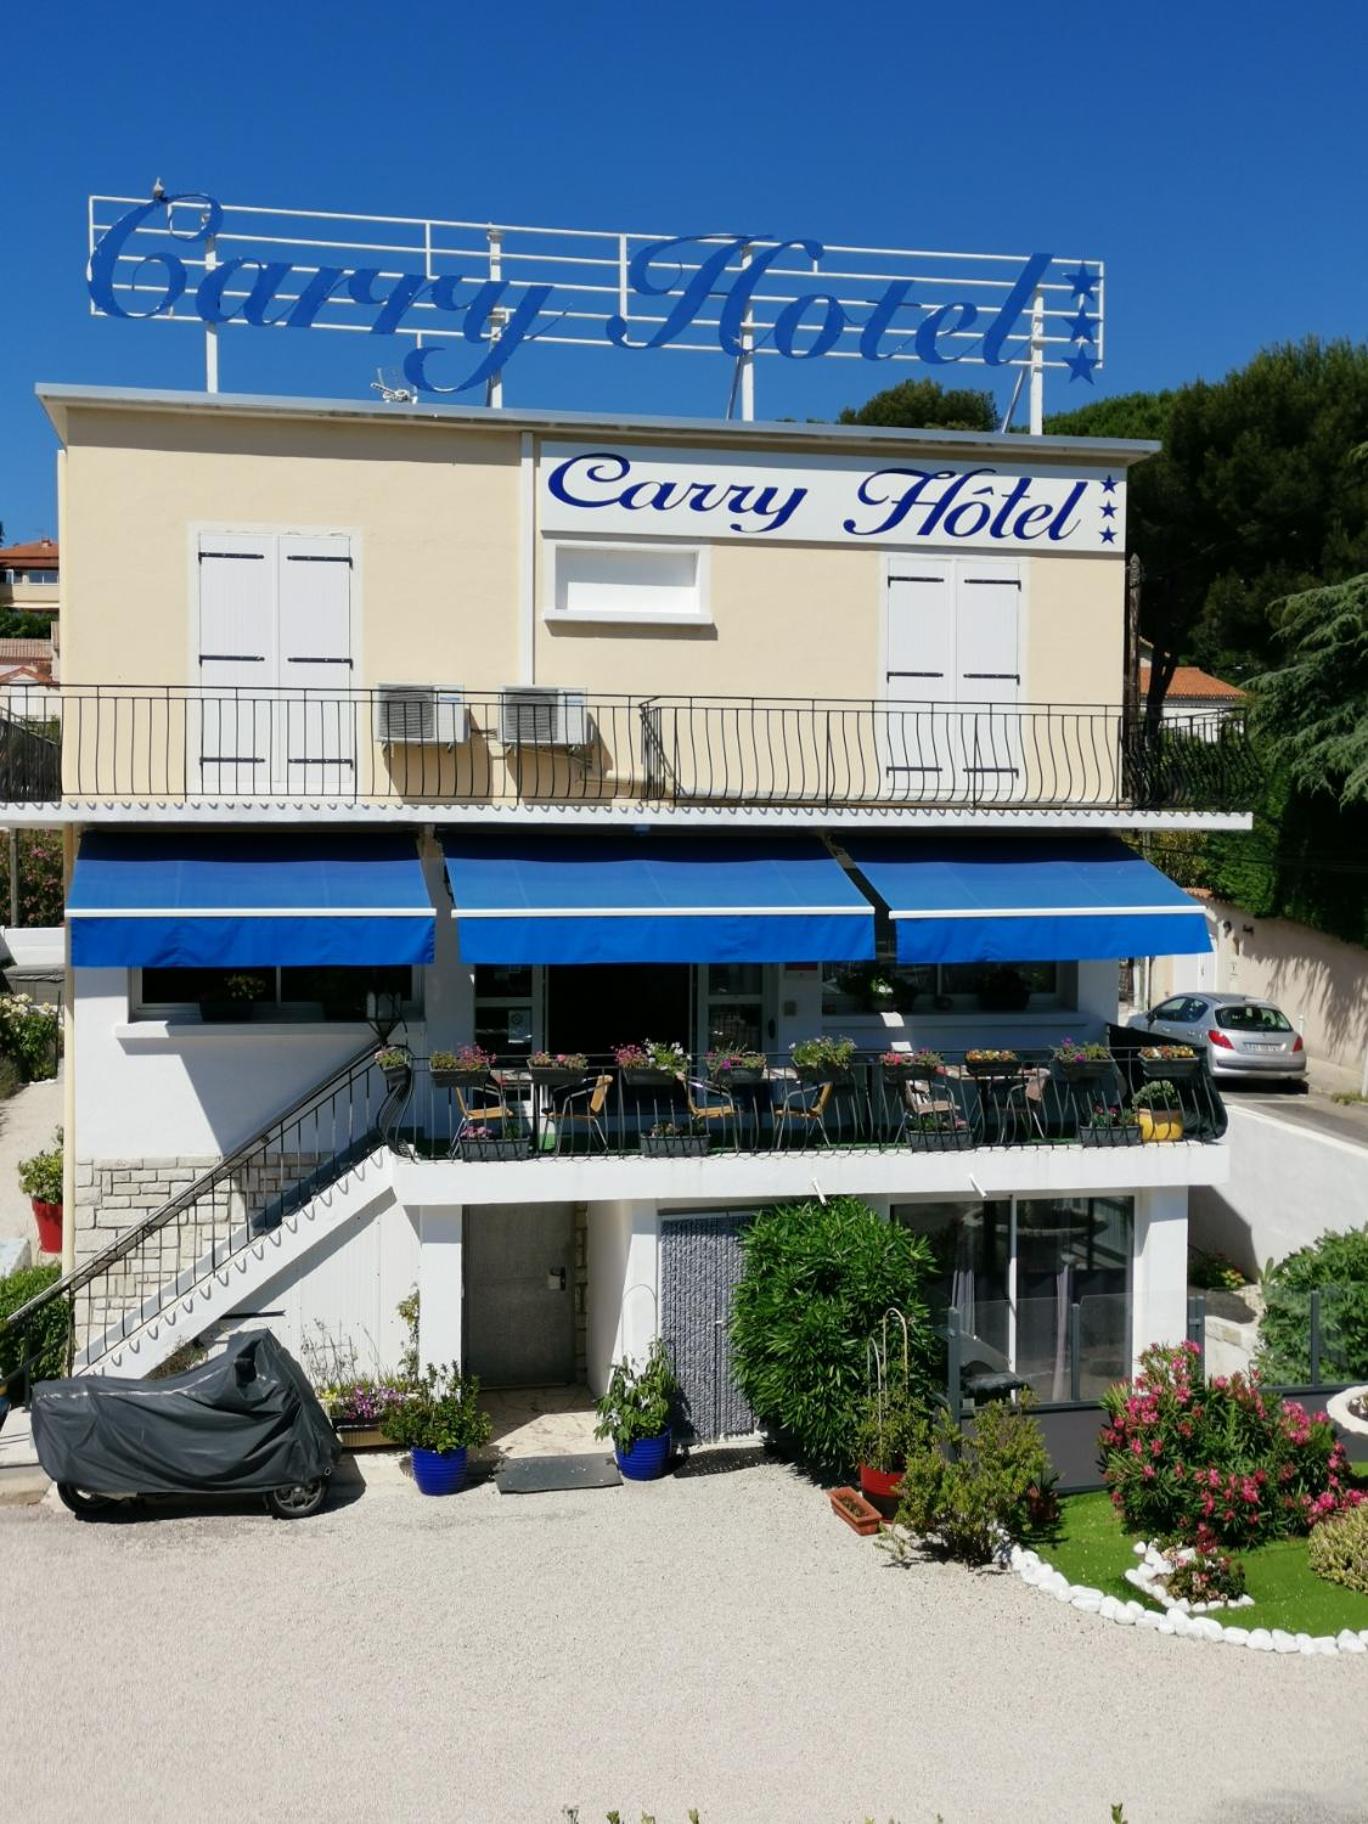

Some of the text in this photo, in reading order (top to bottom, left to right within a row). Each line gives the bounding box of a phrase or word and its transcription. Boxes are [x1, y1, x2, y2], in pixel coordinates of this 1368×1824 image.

[86, 194, 1054, 392] Carry Hotel
[548, 452, 1088, 541] Carry Hôtel
